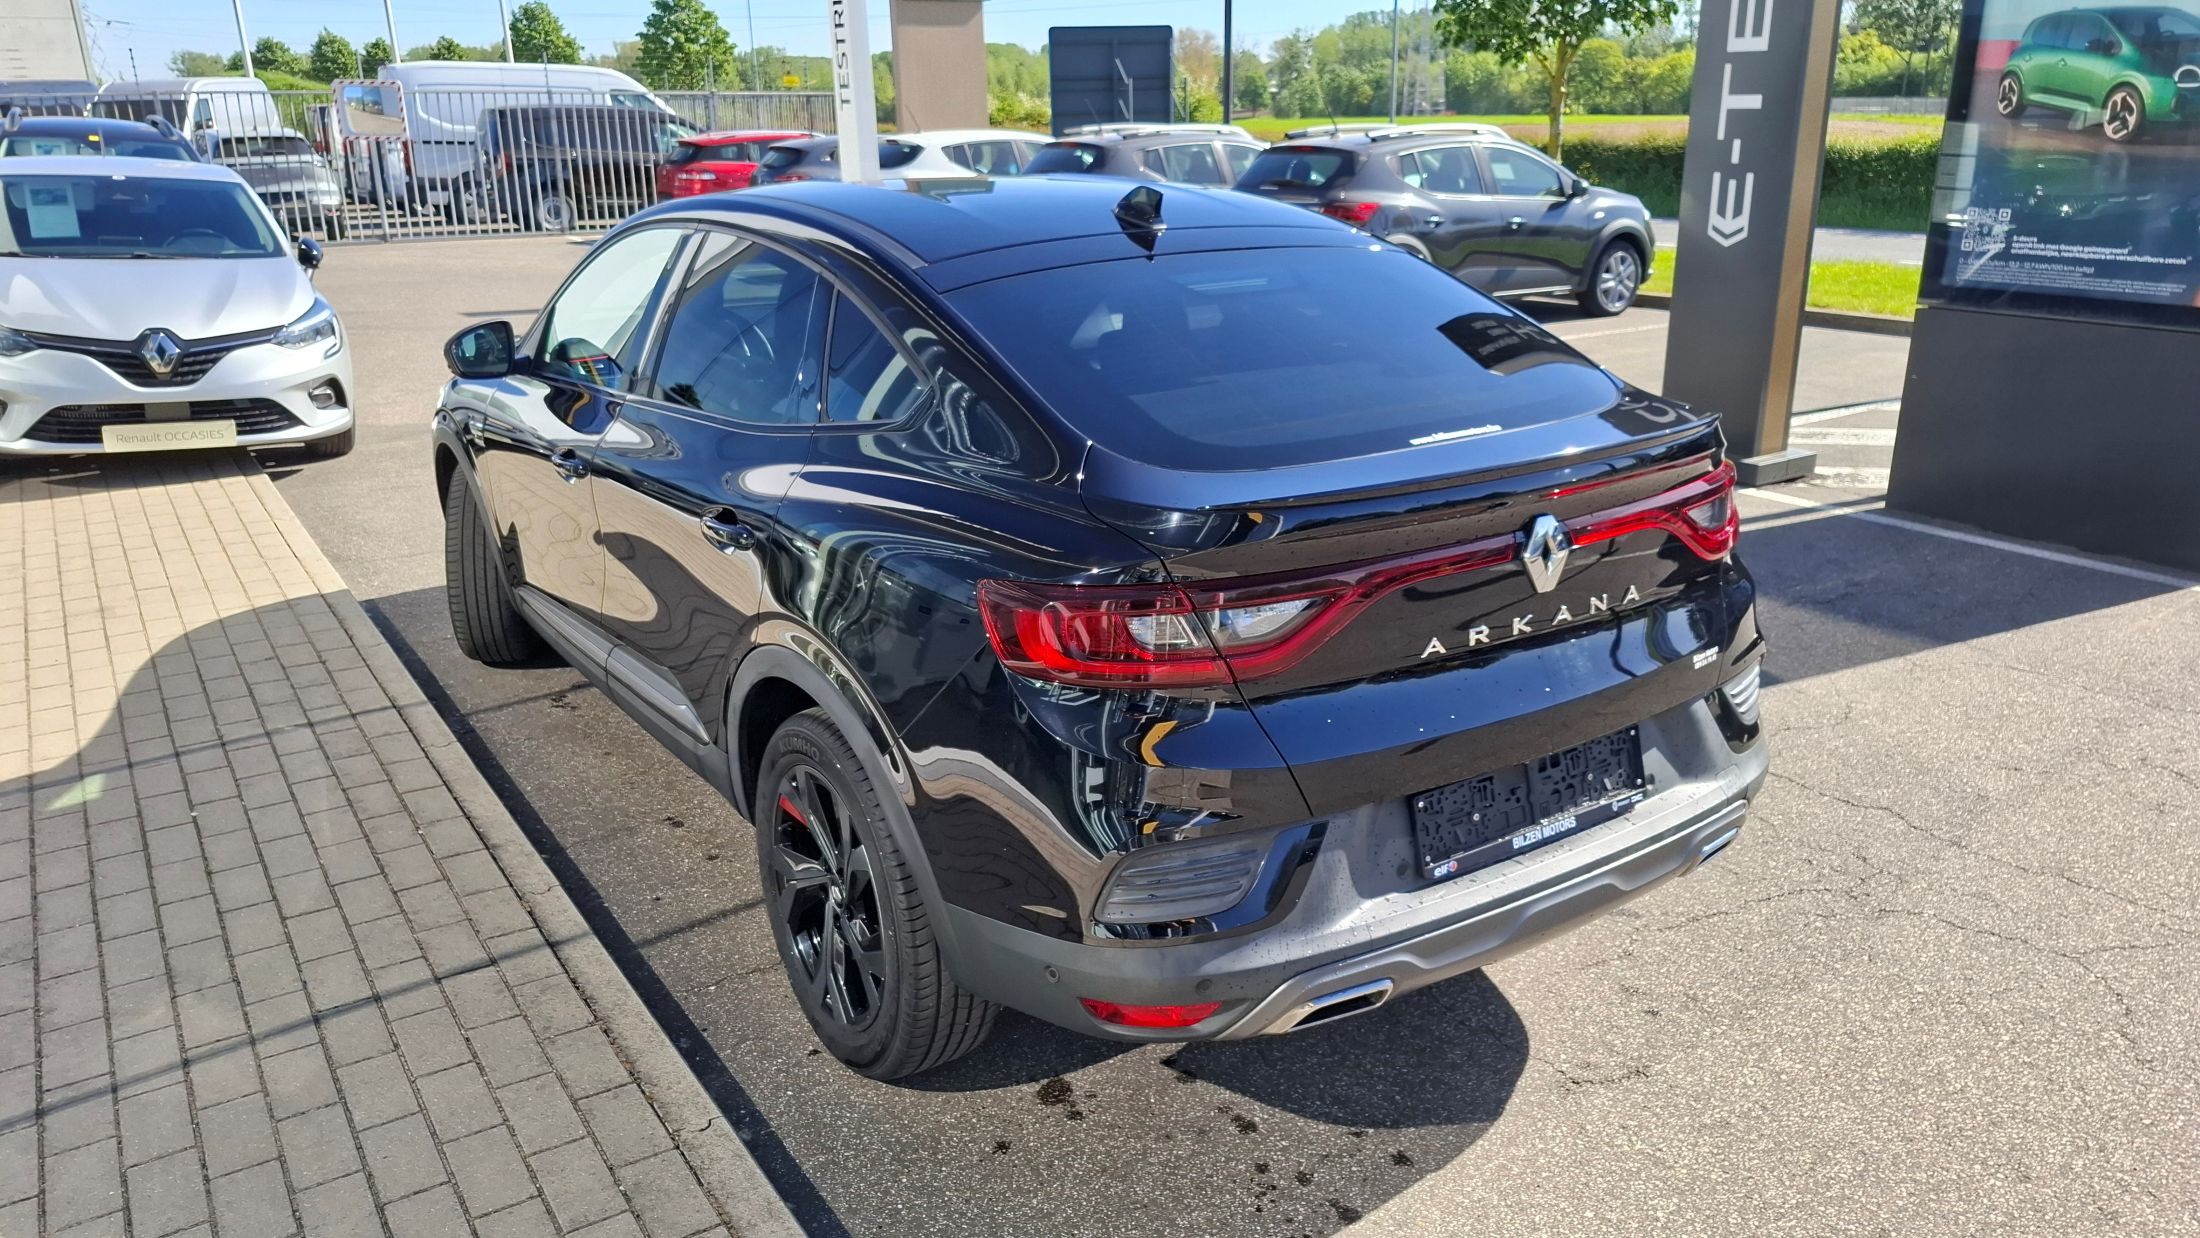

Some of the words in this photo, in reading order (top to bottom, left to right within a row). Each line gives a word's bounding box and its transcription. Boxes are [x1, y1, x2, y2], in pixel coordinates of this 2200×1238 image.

[115, 429, 162, 444] Renault
[164, 428, 225, 442] OCCASIES
[1420, 584, 1641, 659] ARKANA
[779, 736, 820, 761] KUMHO
[1512, 826, 1543, 850] BILZEN
[1543, 816, 1577, 838] MOTORS
[1433, 863, 1449, 877] elf
